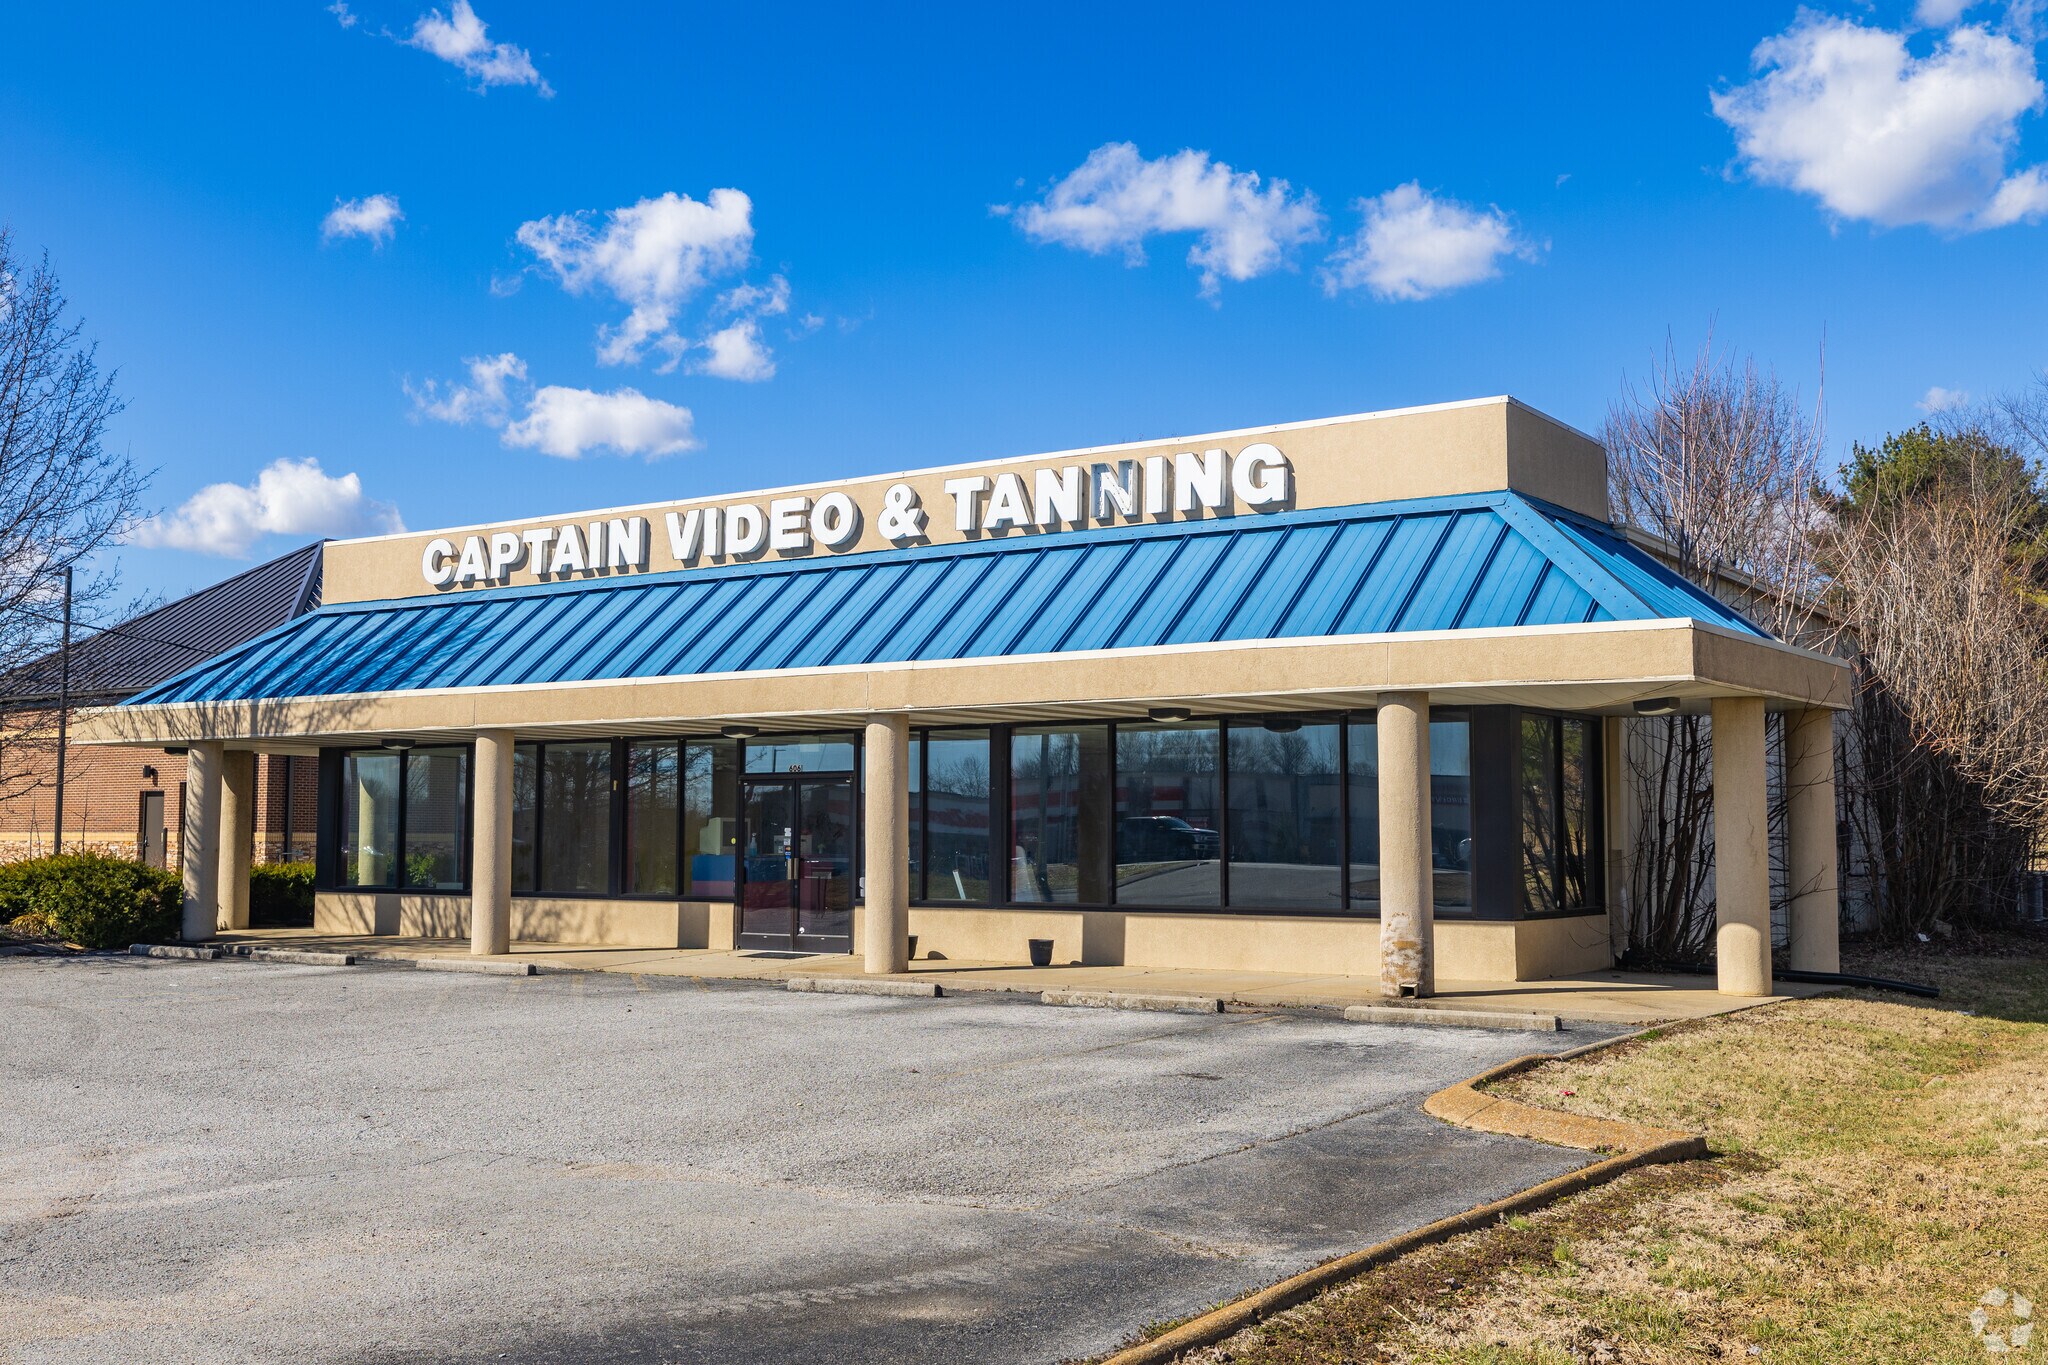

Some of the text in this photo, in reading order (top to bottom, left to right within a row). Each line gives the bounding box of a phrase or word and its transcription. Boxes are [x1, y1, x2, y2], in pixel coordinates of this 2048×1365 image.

[421, 442, 1290, 585] CAPTAIN VIDEO & TANNING
